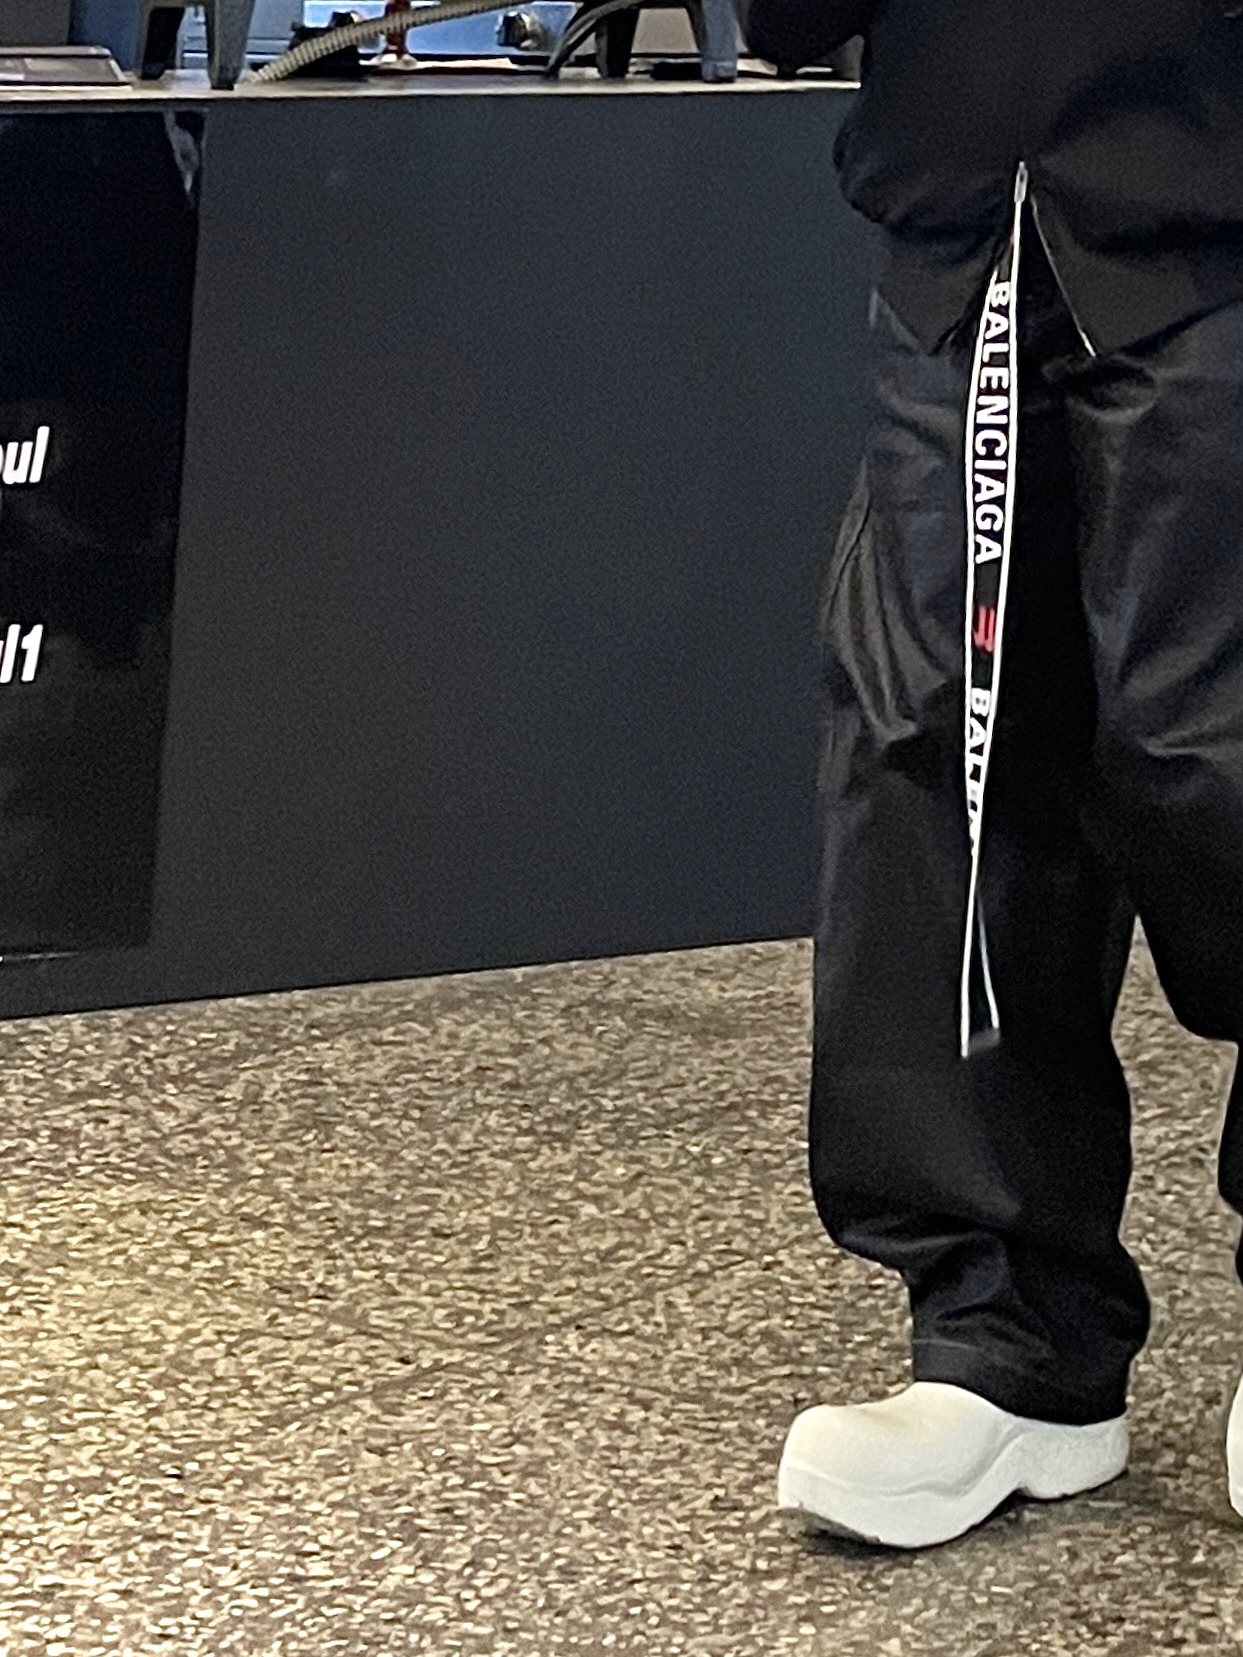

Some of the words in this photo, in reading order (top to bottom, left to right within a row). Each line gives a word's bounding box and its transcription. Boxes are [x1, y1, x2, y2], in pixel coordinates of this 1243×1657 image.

[974, 280, 1011, 565] BALENCIAGA
[0, 425, 50, 485] ul
[0, 623, 44, 684] l1
